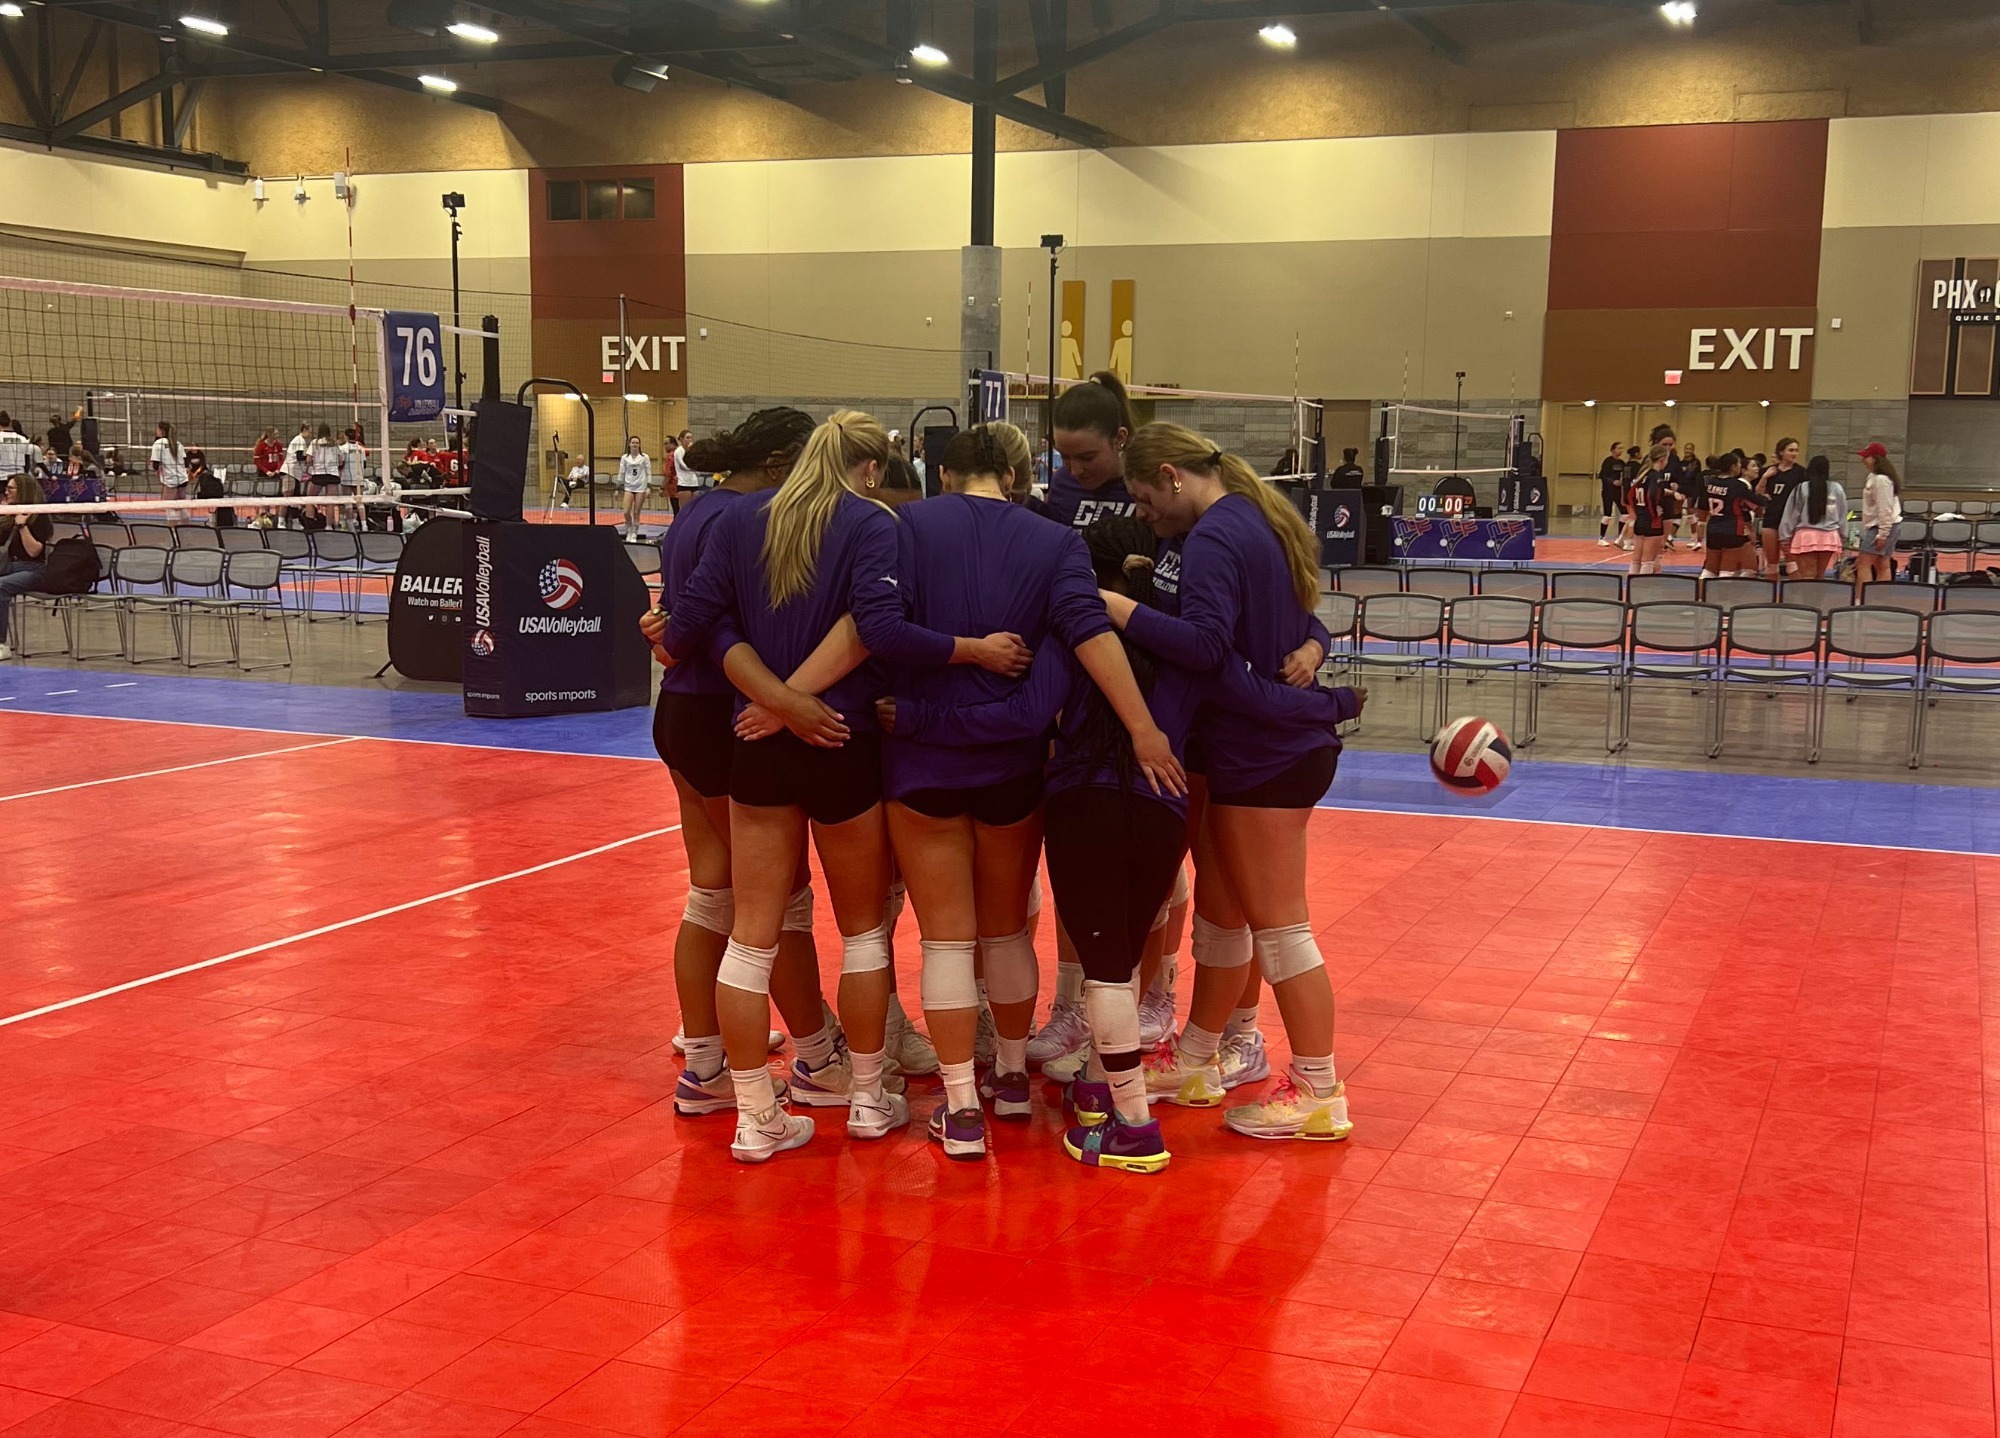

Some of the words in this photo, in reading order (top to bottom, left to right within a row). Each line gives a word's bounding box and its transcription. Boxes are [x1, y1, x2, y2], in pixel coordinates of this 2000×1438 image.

[1932, 279, 1978, 309] PHX
[397, 327, 437, 387] 76
[601, 336, 686, 370] EXIT
[1689, 328, 1814, 370] EXIT
[985, 380, 1001, 417] 77
[1419, 497, 1436, 511] 00
[1445, 498, 1462, 512] 00
[476, 535, 493, 627] USAVolleyball
[408, 597, 429, 606] Watch
[519, 616, 602, 637] USAVolleyball
[525, 690, 558, 703] sports
[559, 689, 597, 702] imports
